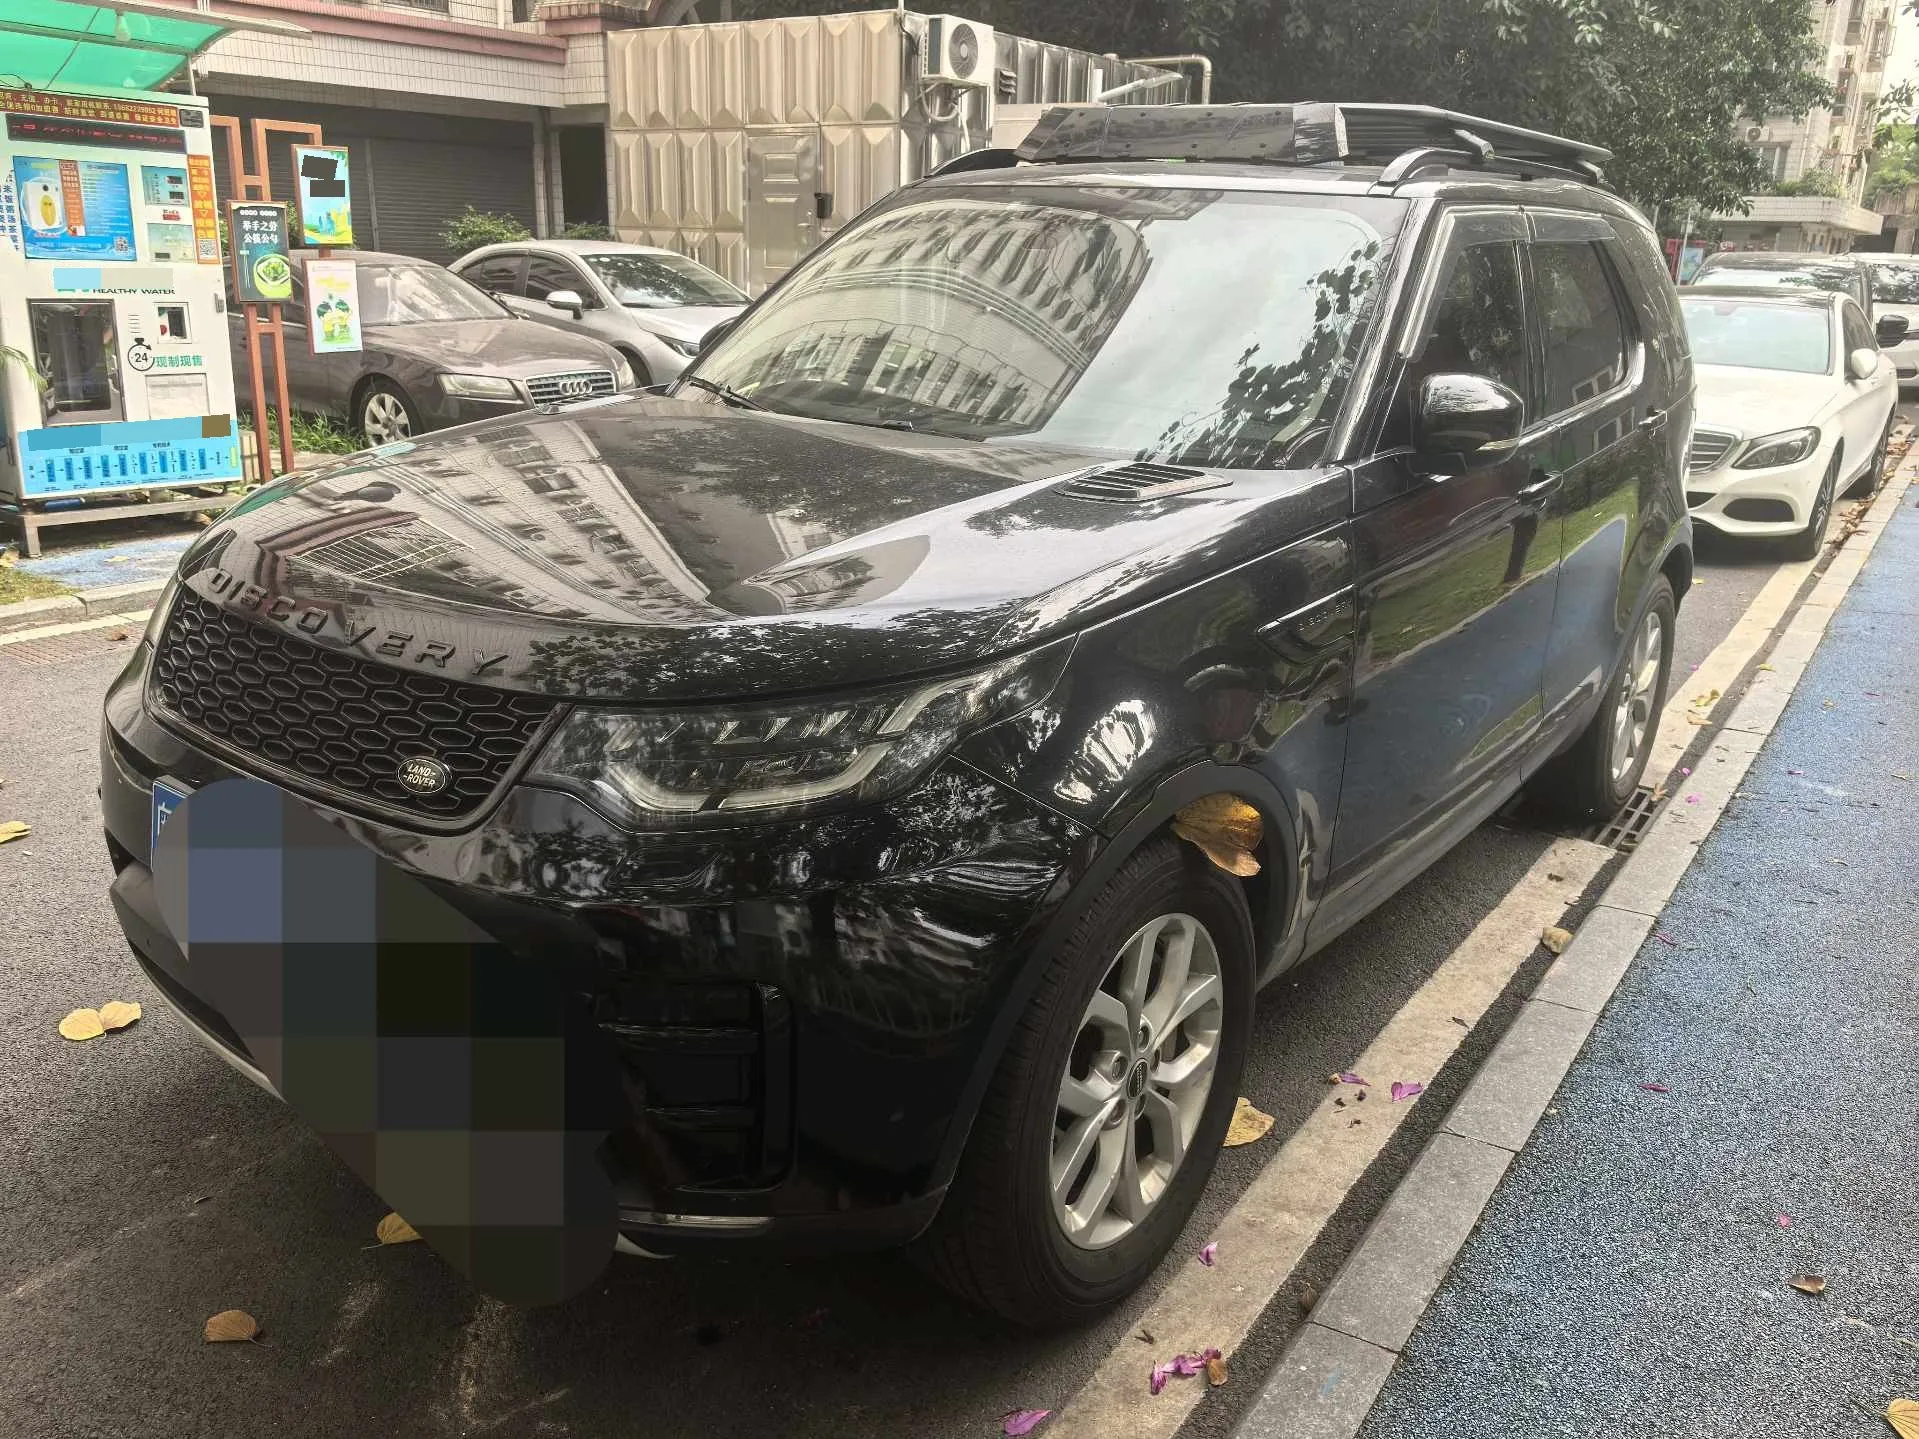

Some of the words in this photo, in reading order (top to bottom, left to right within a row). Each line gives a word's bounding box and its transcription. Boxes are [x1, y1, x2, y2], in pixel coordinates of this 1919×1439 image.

[134, 352, 148, 363] 24
[156, 355, 203, 368] 现制现售
[207, 568, 509, 676] DISCOVERY
